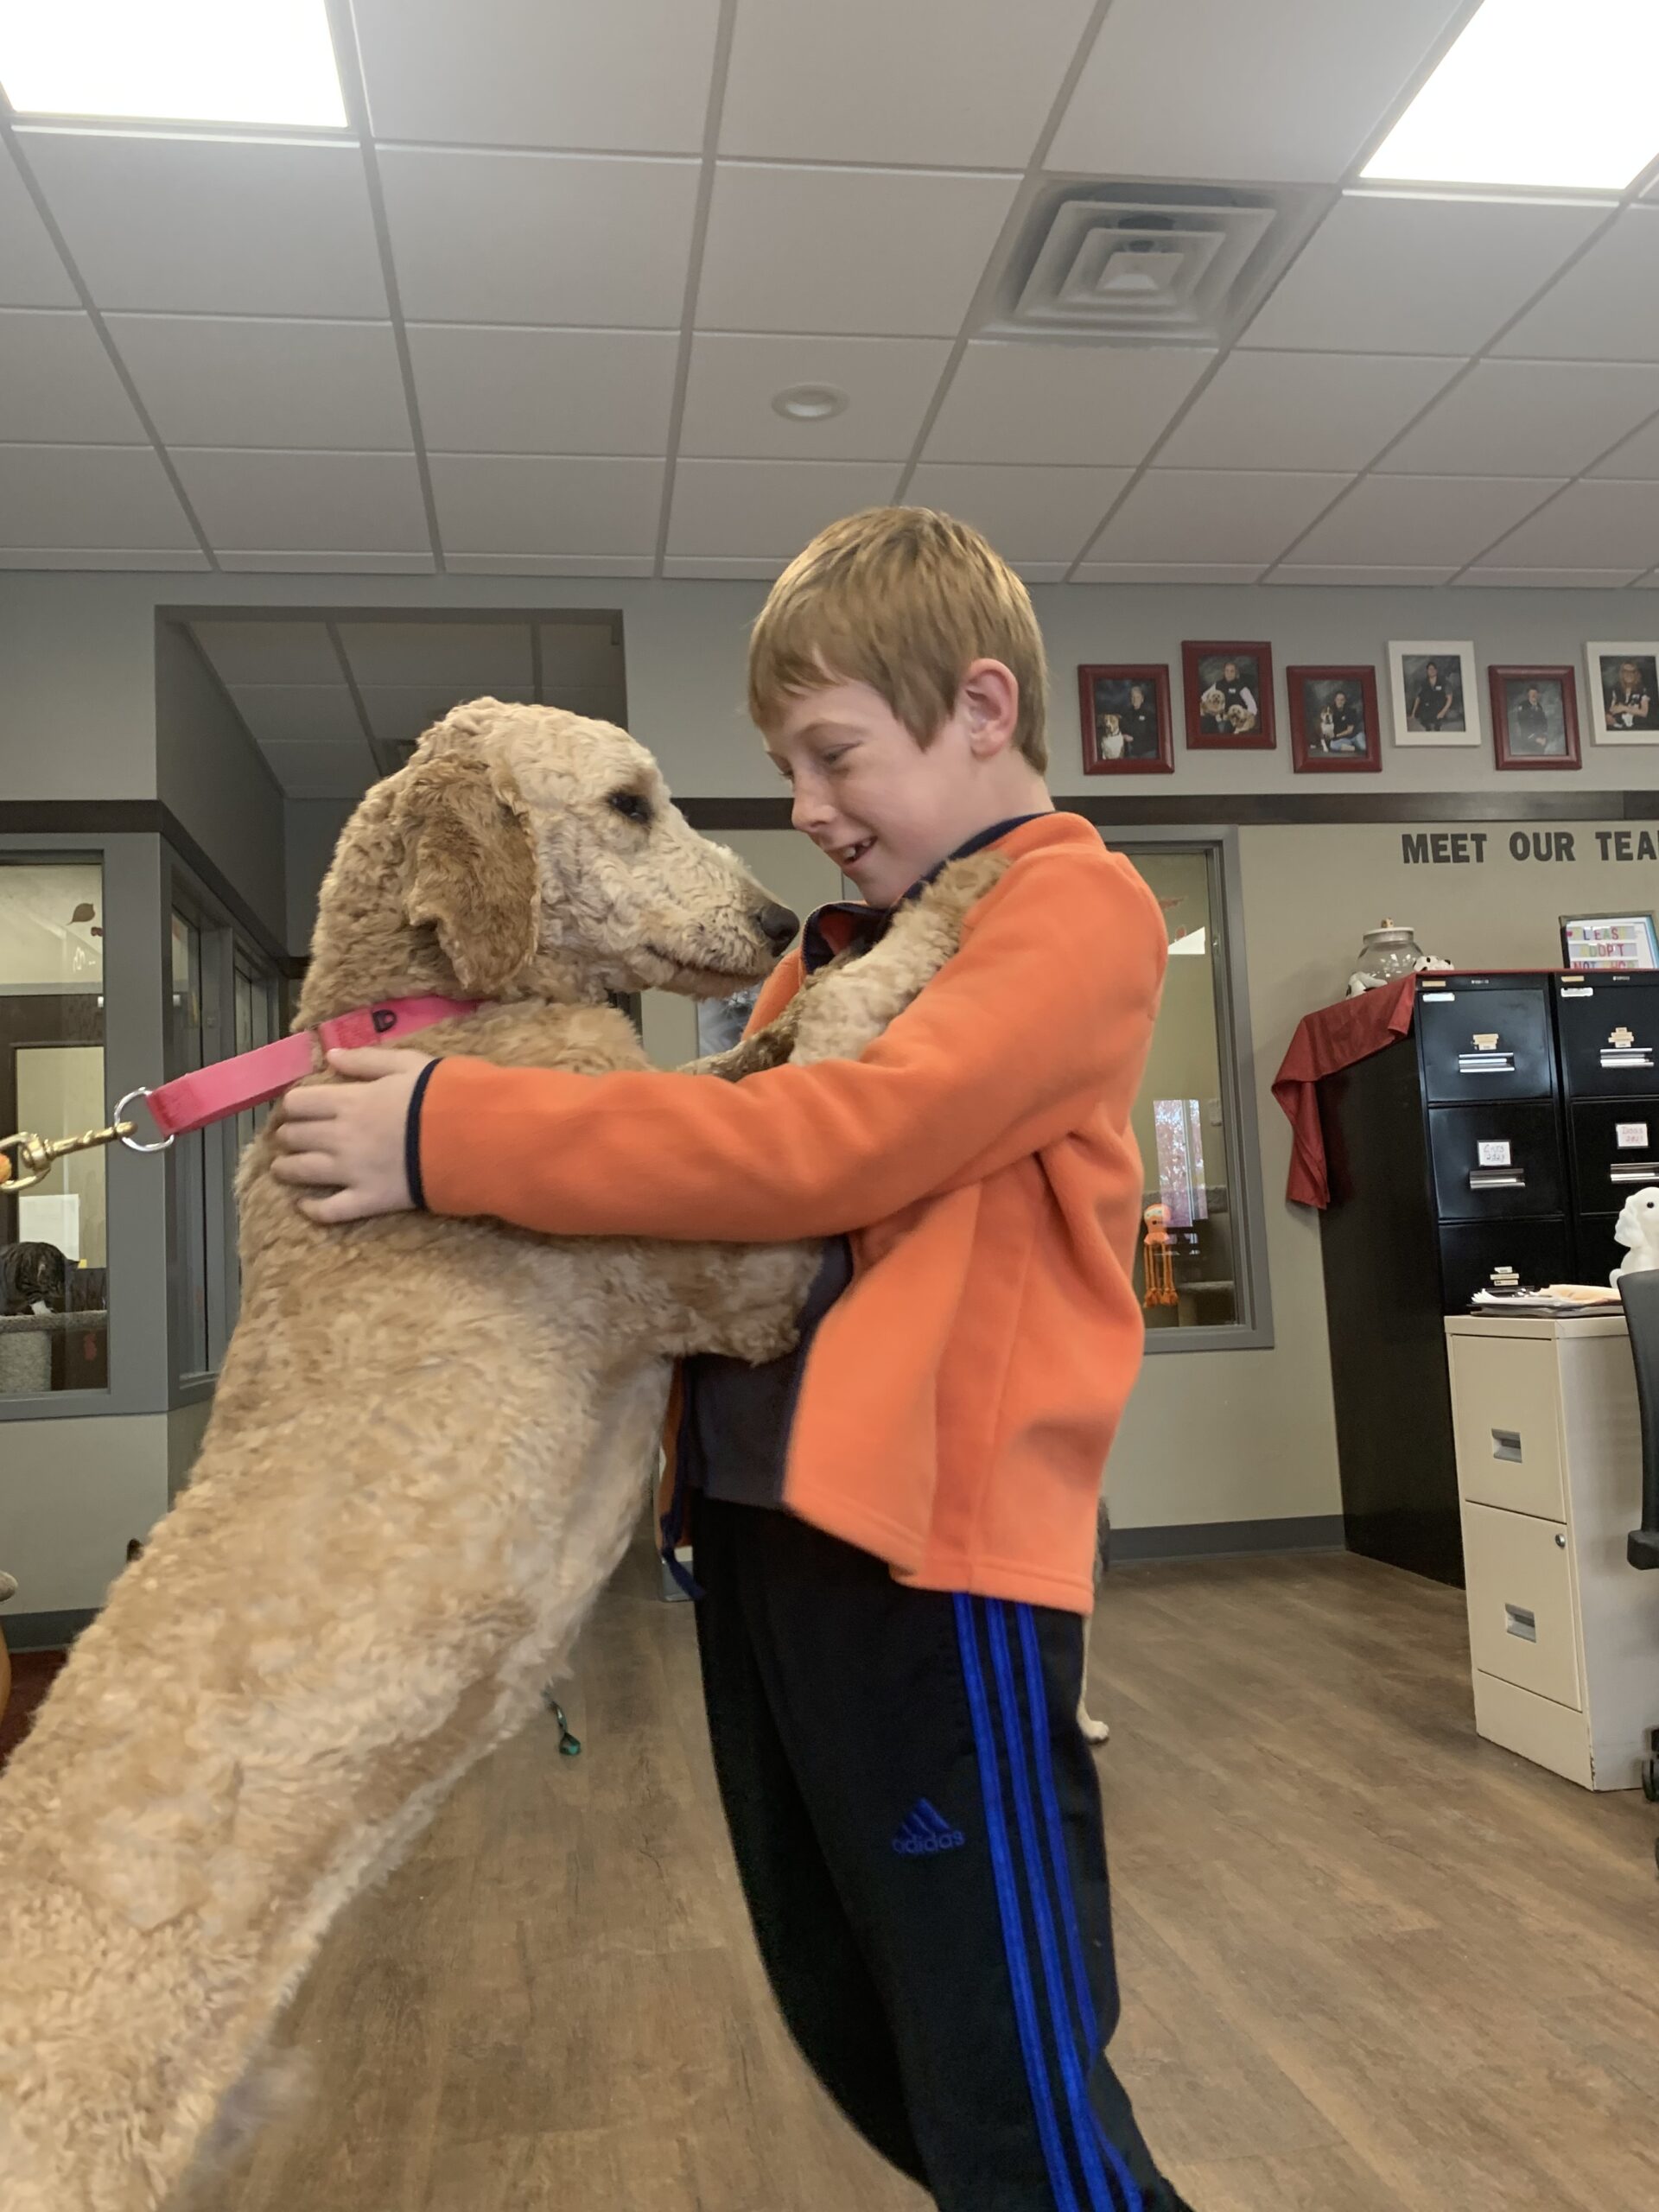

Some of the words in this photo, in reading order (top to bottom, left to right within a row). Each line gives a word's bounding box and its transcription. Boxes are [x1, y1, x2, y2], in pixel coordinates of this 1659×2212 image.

[1402, 833, 1487, 864] MEET
[1509, 831, 1575, 861] OUR
[1595, 830, 1659, 861] TEA
[892, 1830, 966, 1854] adidas
